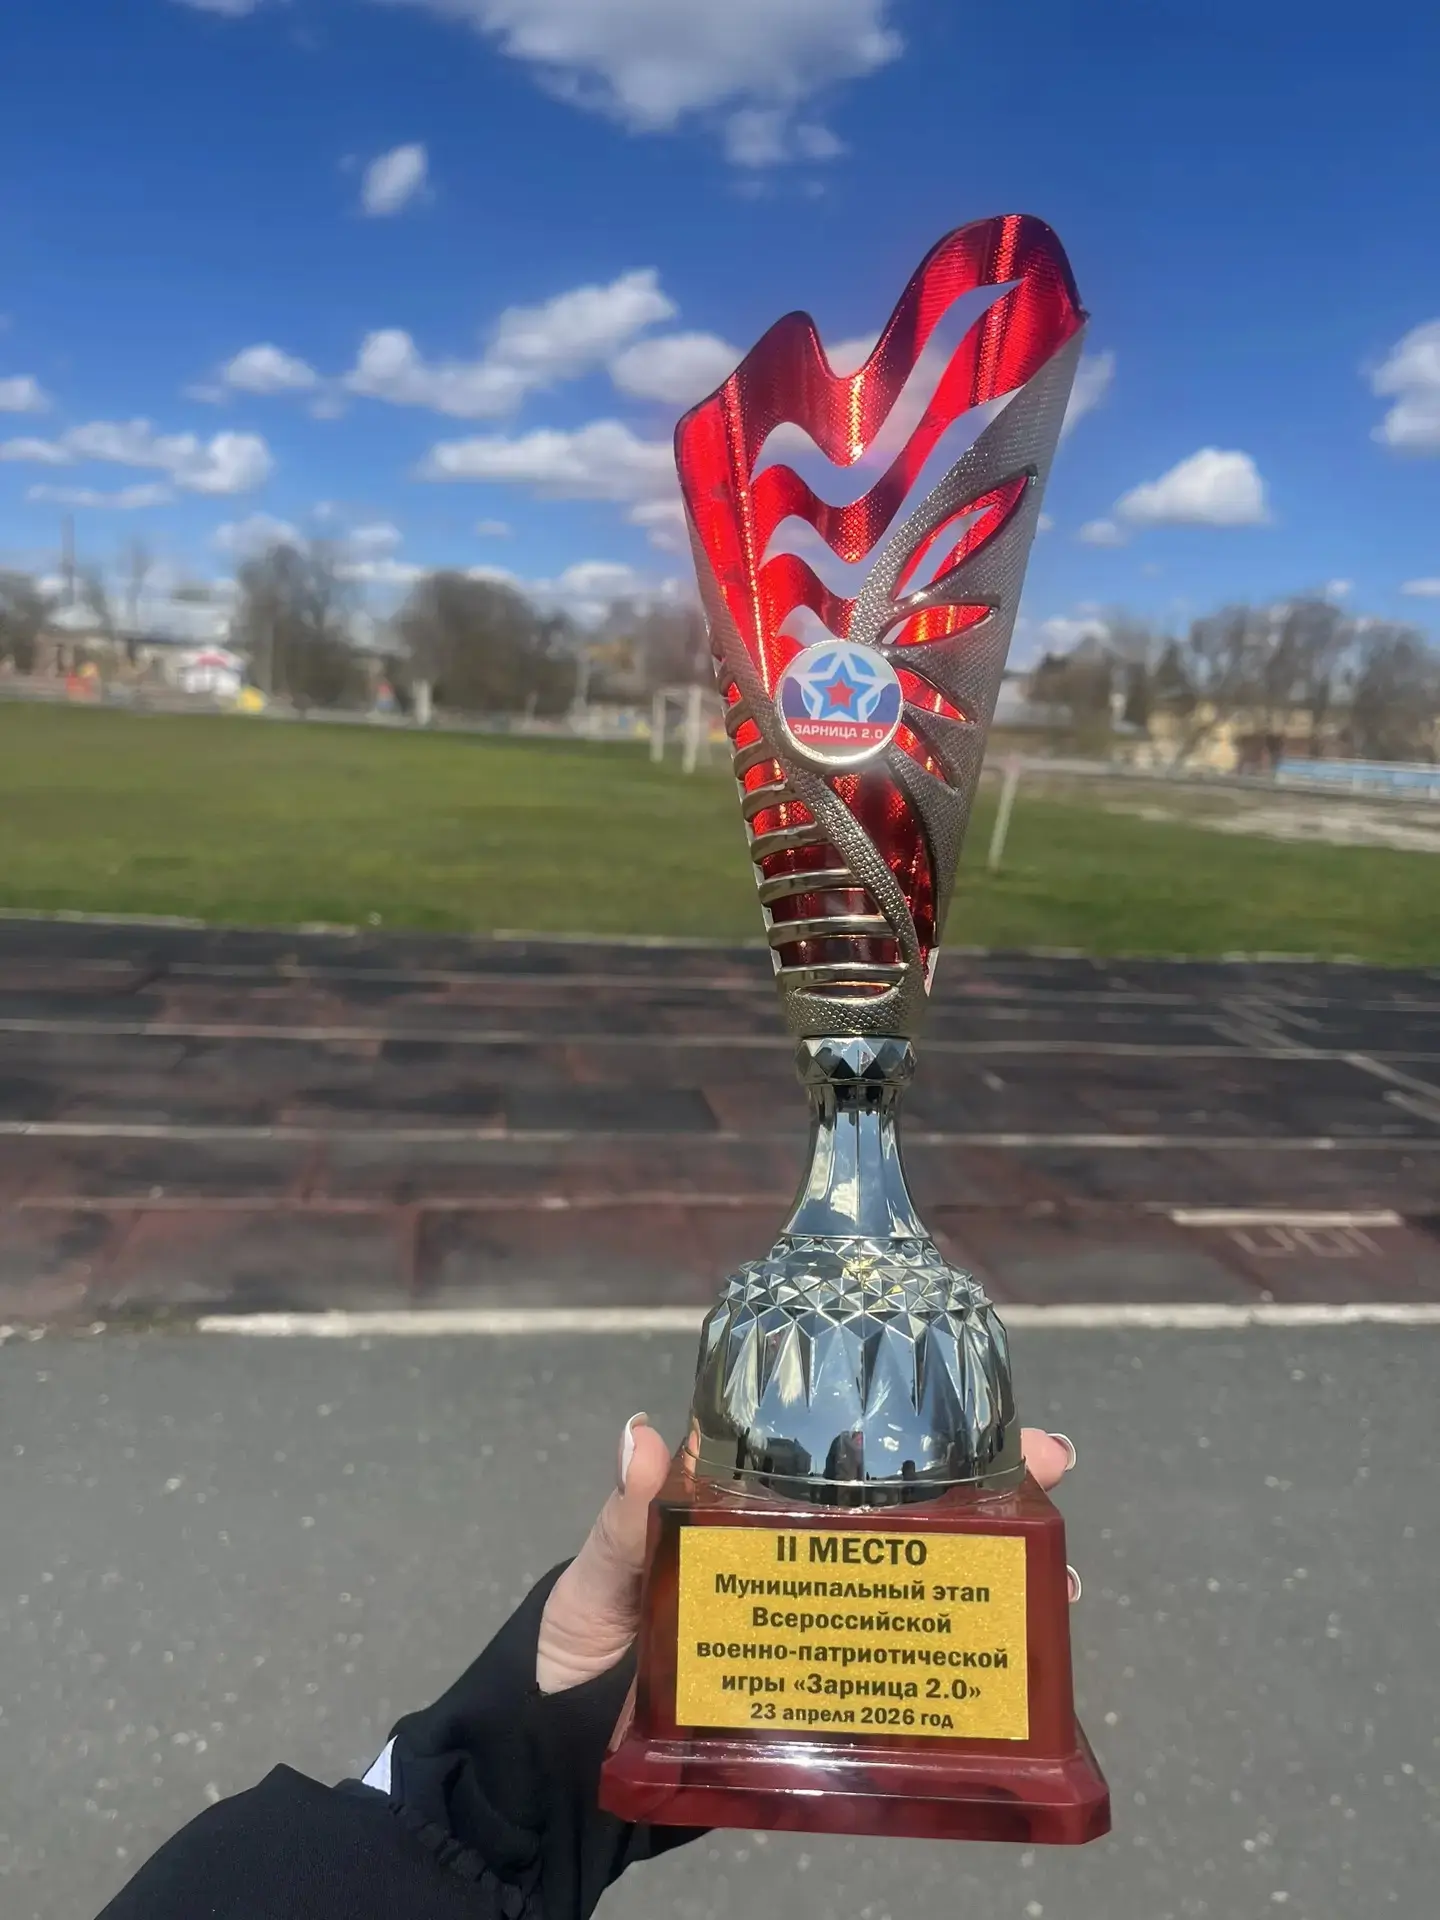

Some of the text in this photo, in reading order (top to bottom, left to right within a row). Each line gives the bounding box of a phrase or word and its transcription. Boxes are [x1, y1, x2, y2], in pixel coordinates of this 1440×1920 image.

[794, 724, 884, 739] ЗАРНИЦА 2.0
[776, 1535, 927, 1566] II МЕСТО
[715, 1574, 990, 1602] Муниципальный этап
[752, 1607, 951, 1633] Всероссийской
[697, 1642, 1008, 1668] военно-патриотической
[721, 1673, 981, 1701] игры «Зарница 2.0»
[750, 1703, 954, 1729] 23 апреля 2026 год
